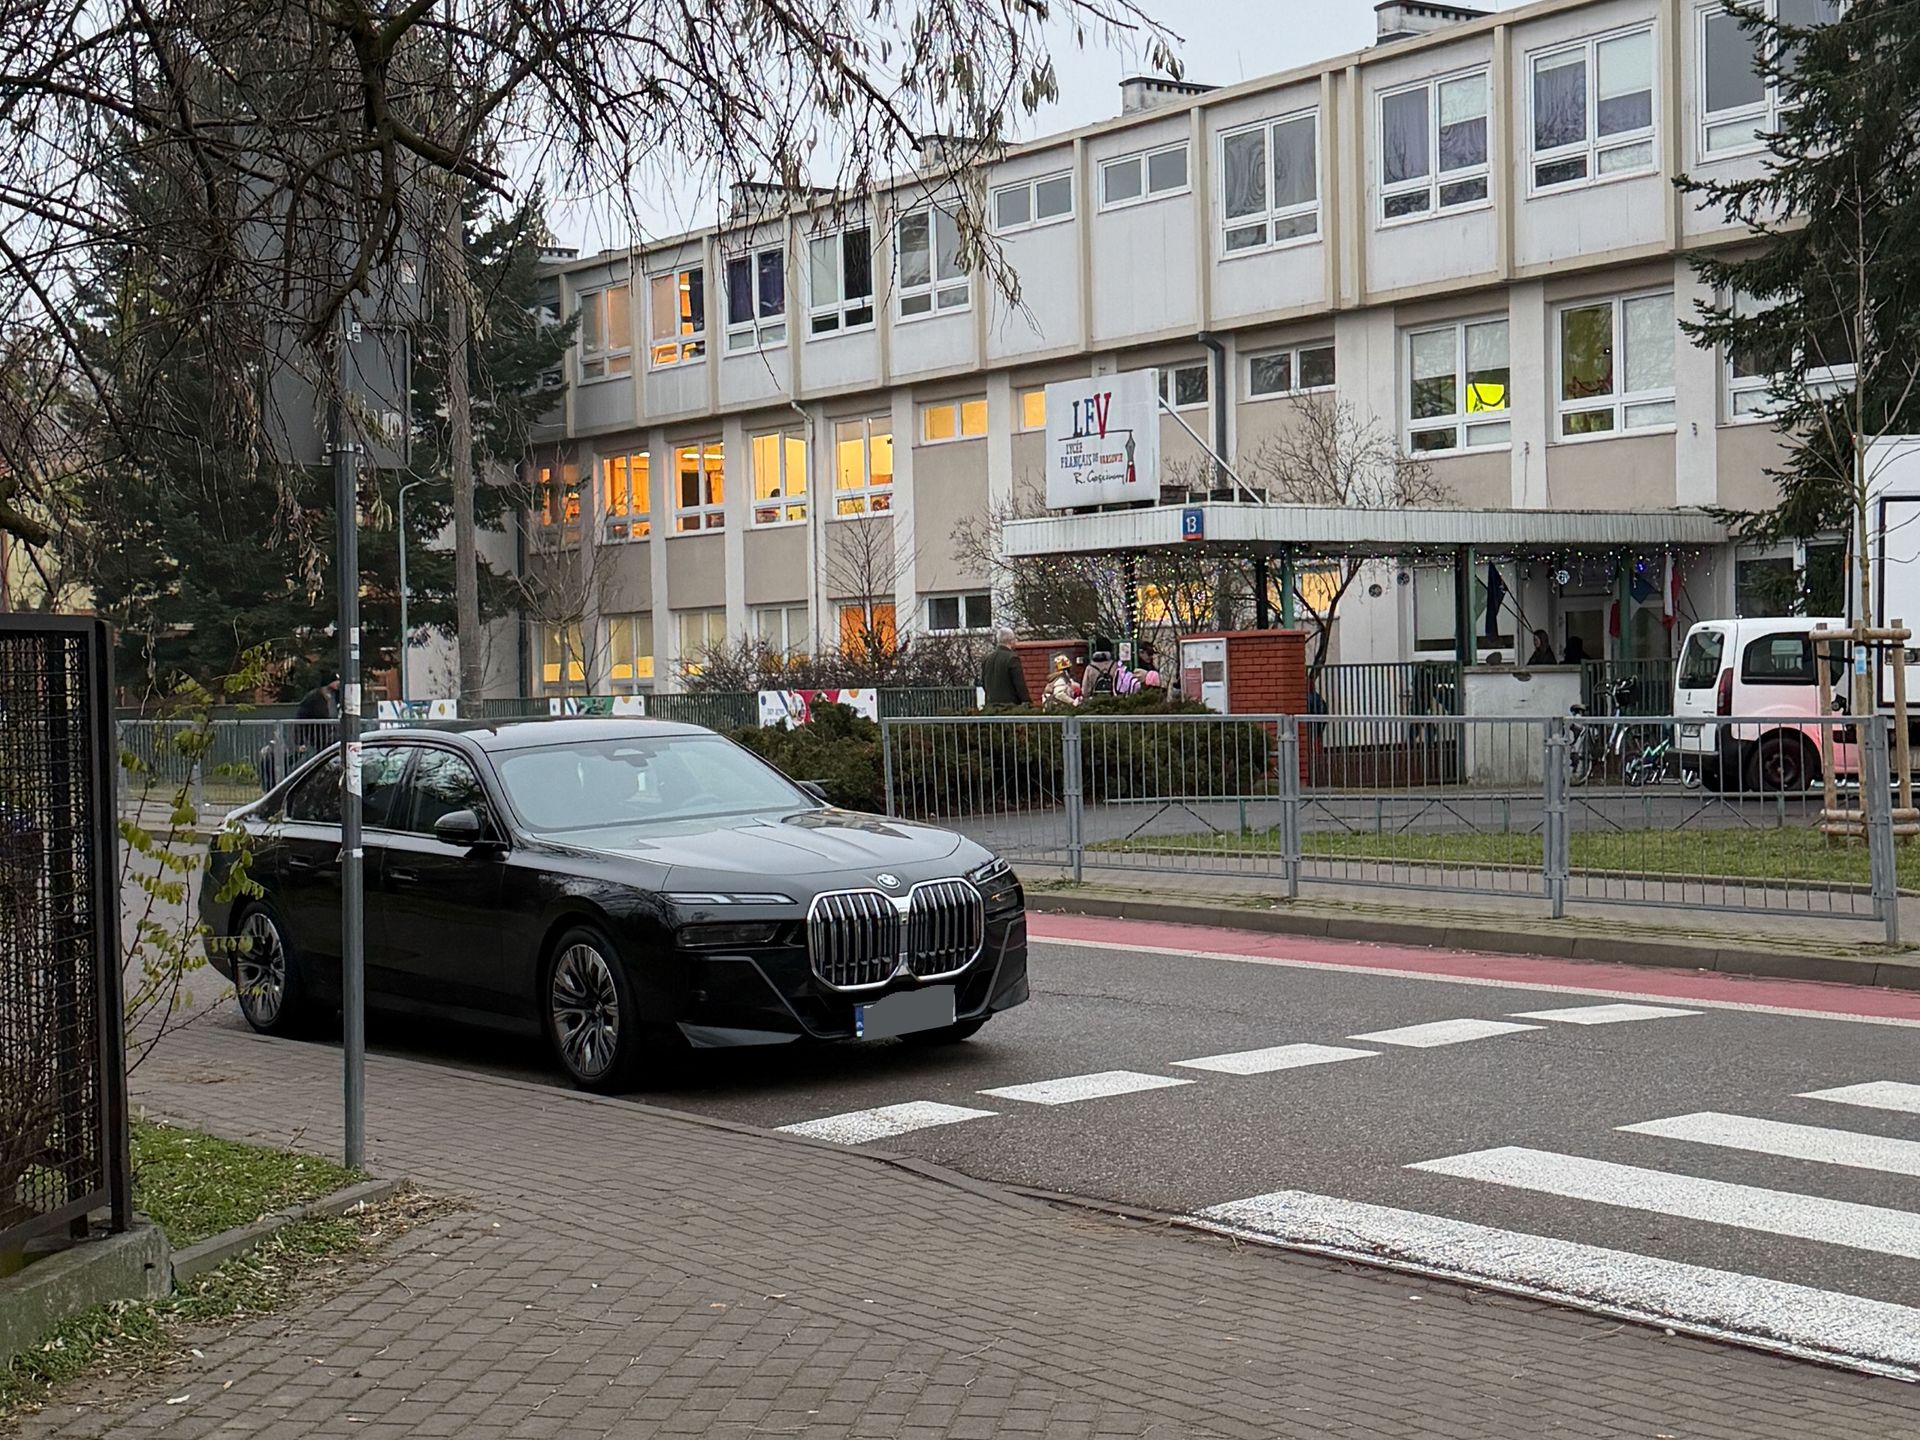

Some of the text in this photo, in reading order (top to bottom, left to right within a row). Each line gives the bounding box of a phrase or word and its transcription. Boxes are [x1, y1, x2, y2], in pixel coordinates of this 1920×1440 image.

[1072, 392, 1112, 439] LFV
[1060, 454, 1092, 470] FRANÇAIS
[1186, 516, 1197, 533] 13
